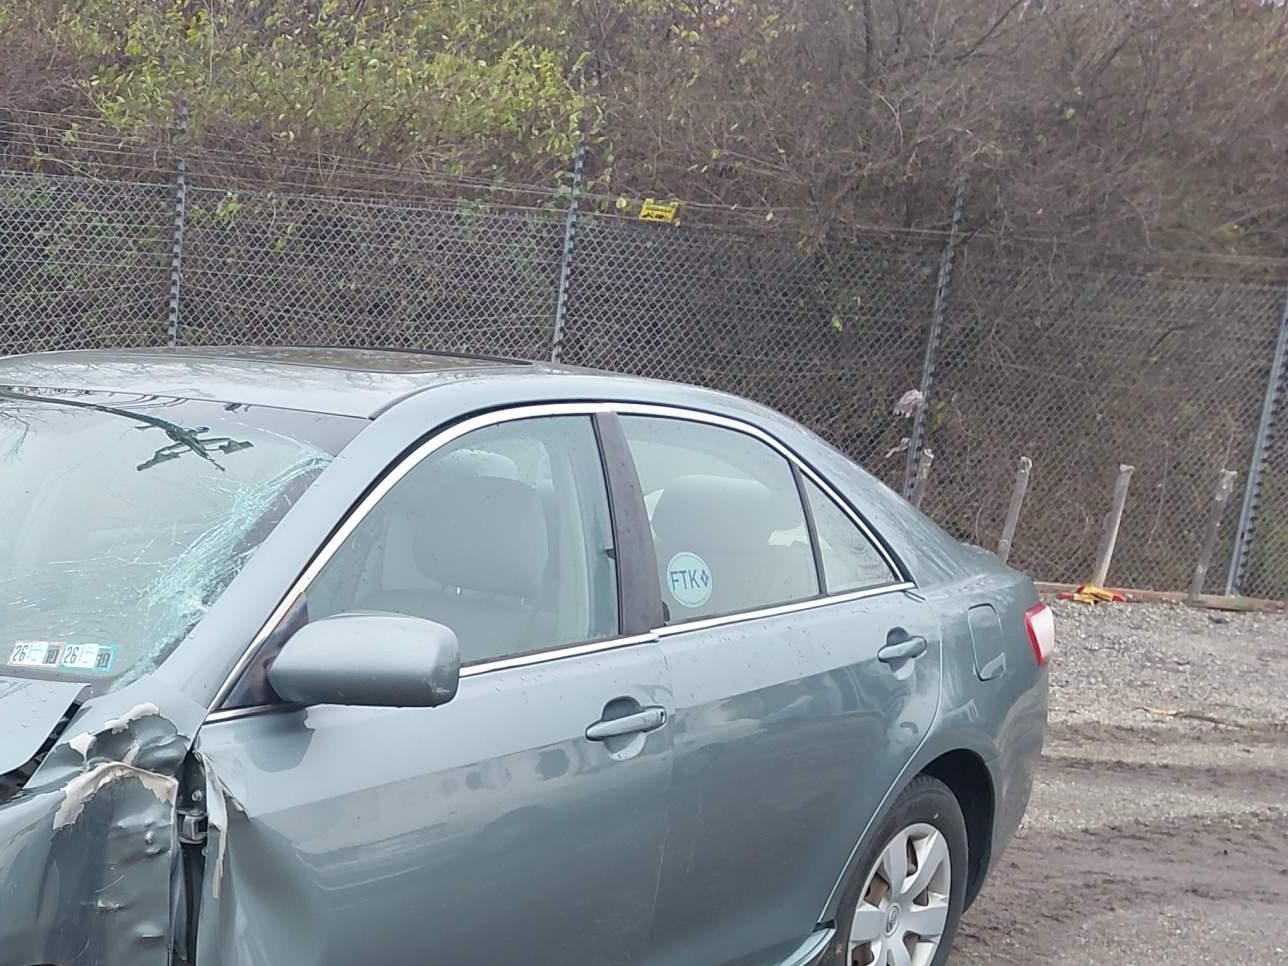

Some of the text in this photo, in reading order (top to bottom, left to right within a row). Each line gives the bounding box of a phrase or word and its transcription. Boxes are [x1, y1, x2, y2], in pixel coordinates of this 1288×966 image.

[671, 570, 700, 590] FTK
[12, 645, 28, 662] 26
[64, 647, 79, 664] 26
